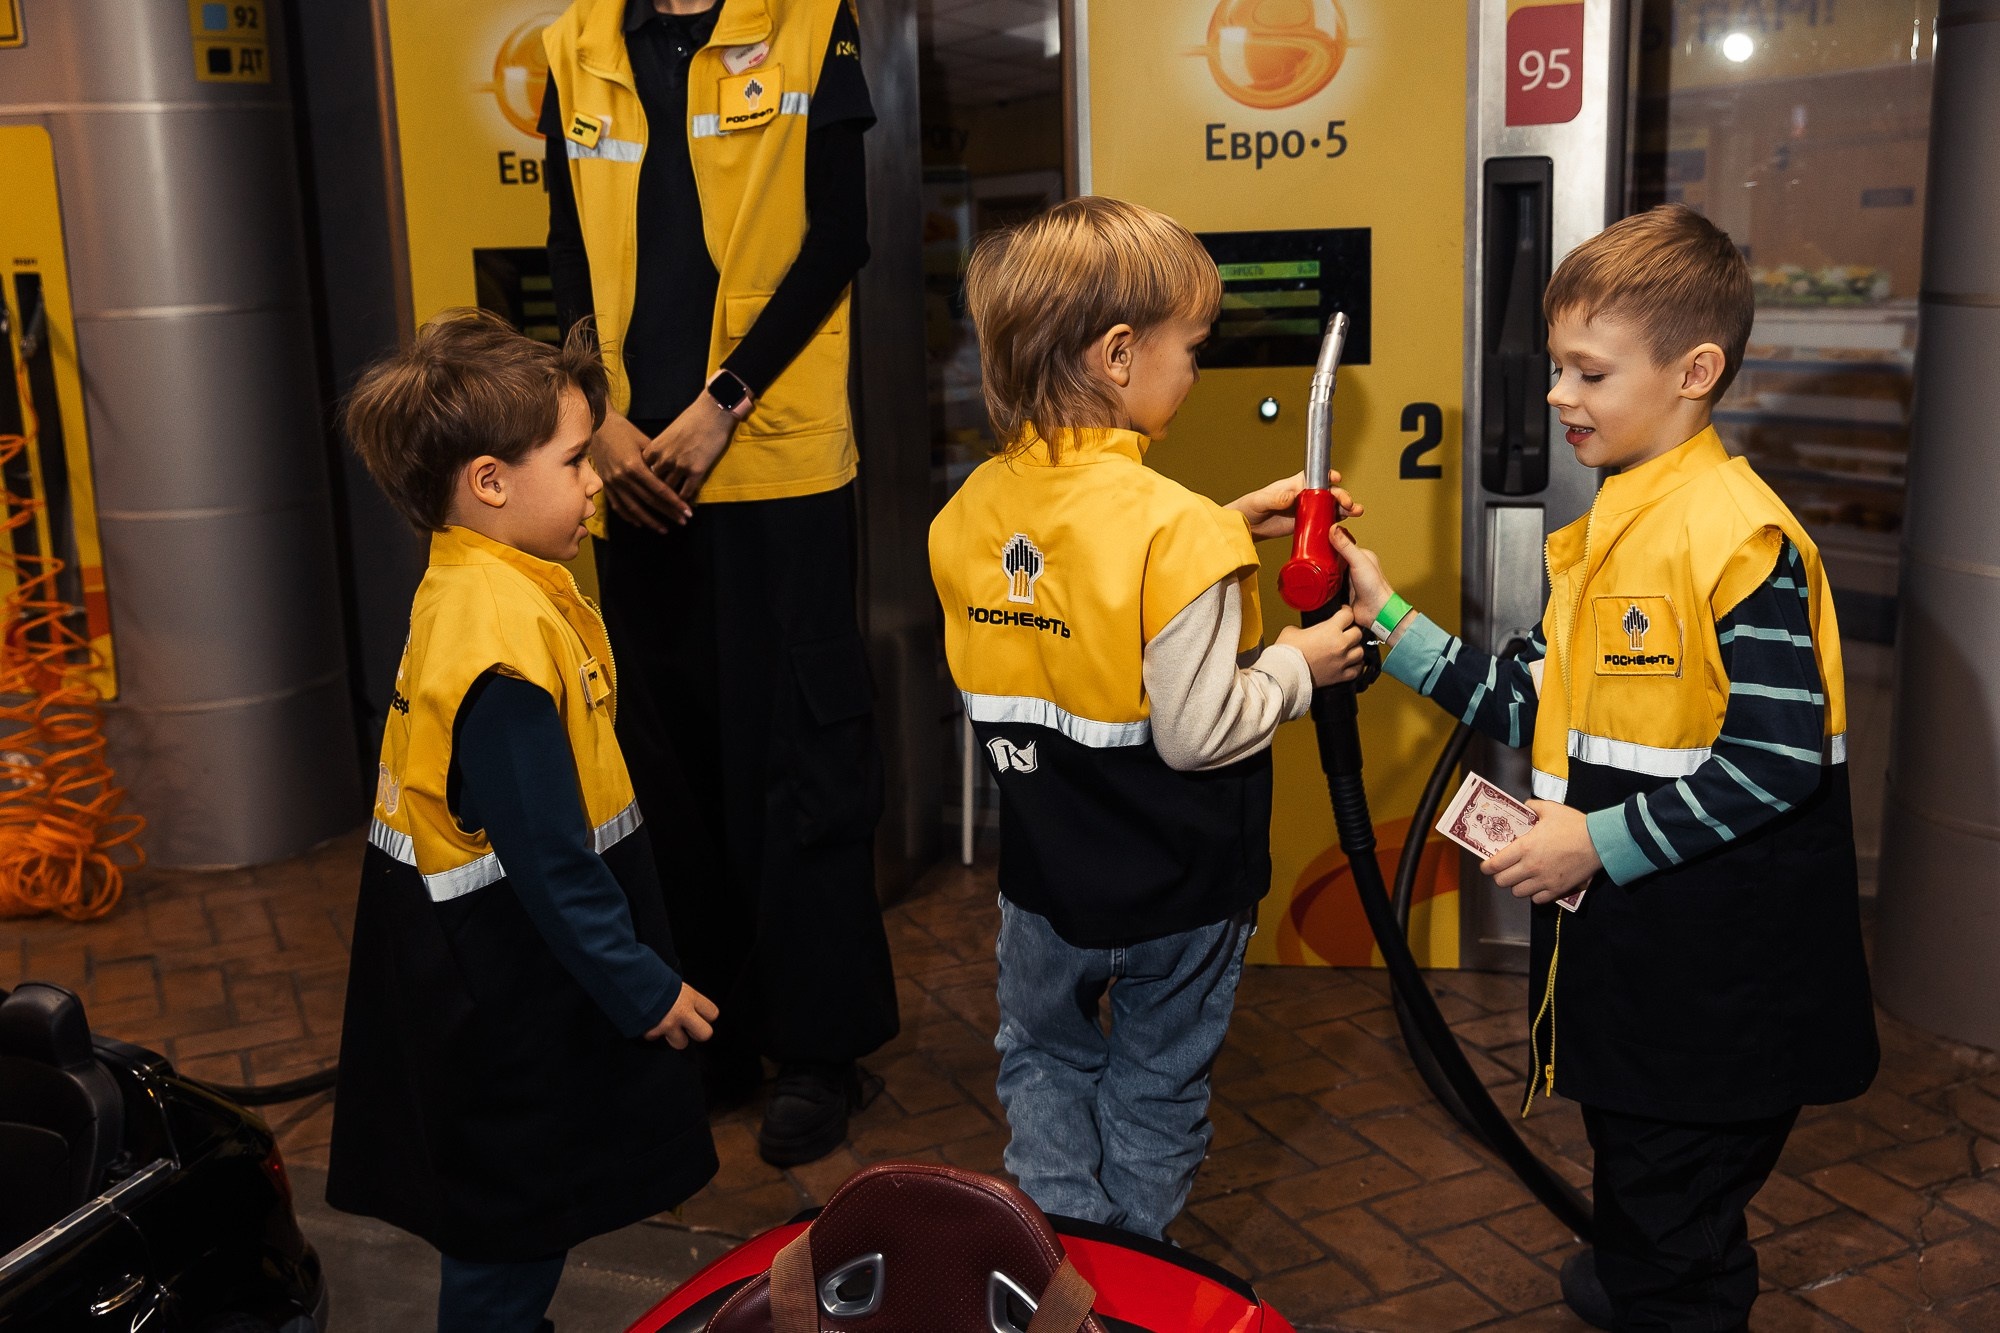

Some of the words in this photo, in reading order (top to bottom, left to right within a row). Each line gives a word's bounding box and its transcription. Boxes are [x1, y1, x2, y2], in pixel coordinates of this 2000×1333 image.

[234, 5, 258, 28] 92
[239, 48, 263, 74] ДТ
[1518, 48, 1571, 91] 95
[1399, 402, 1443, 479] 2
[967, 606, 1071, 639] РОСНЕФТЬ
[1604, 654, 1675, 666] РОСНЕФТЬ
